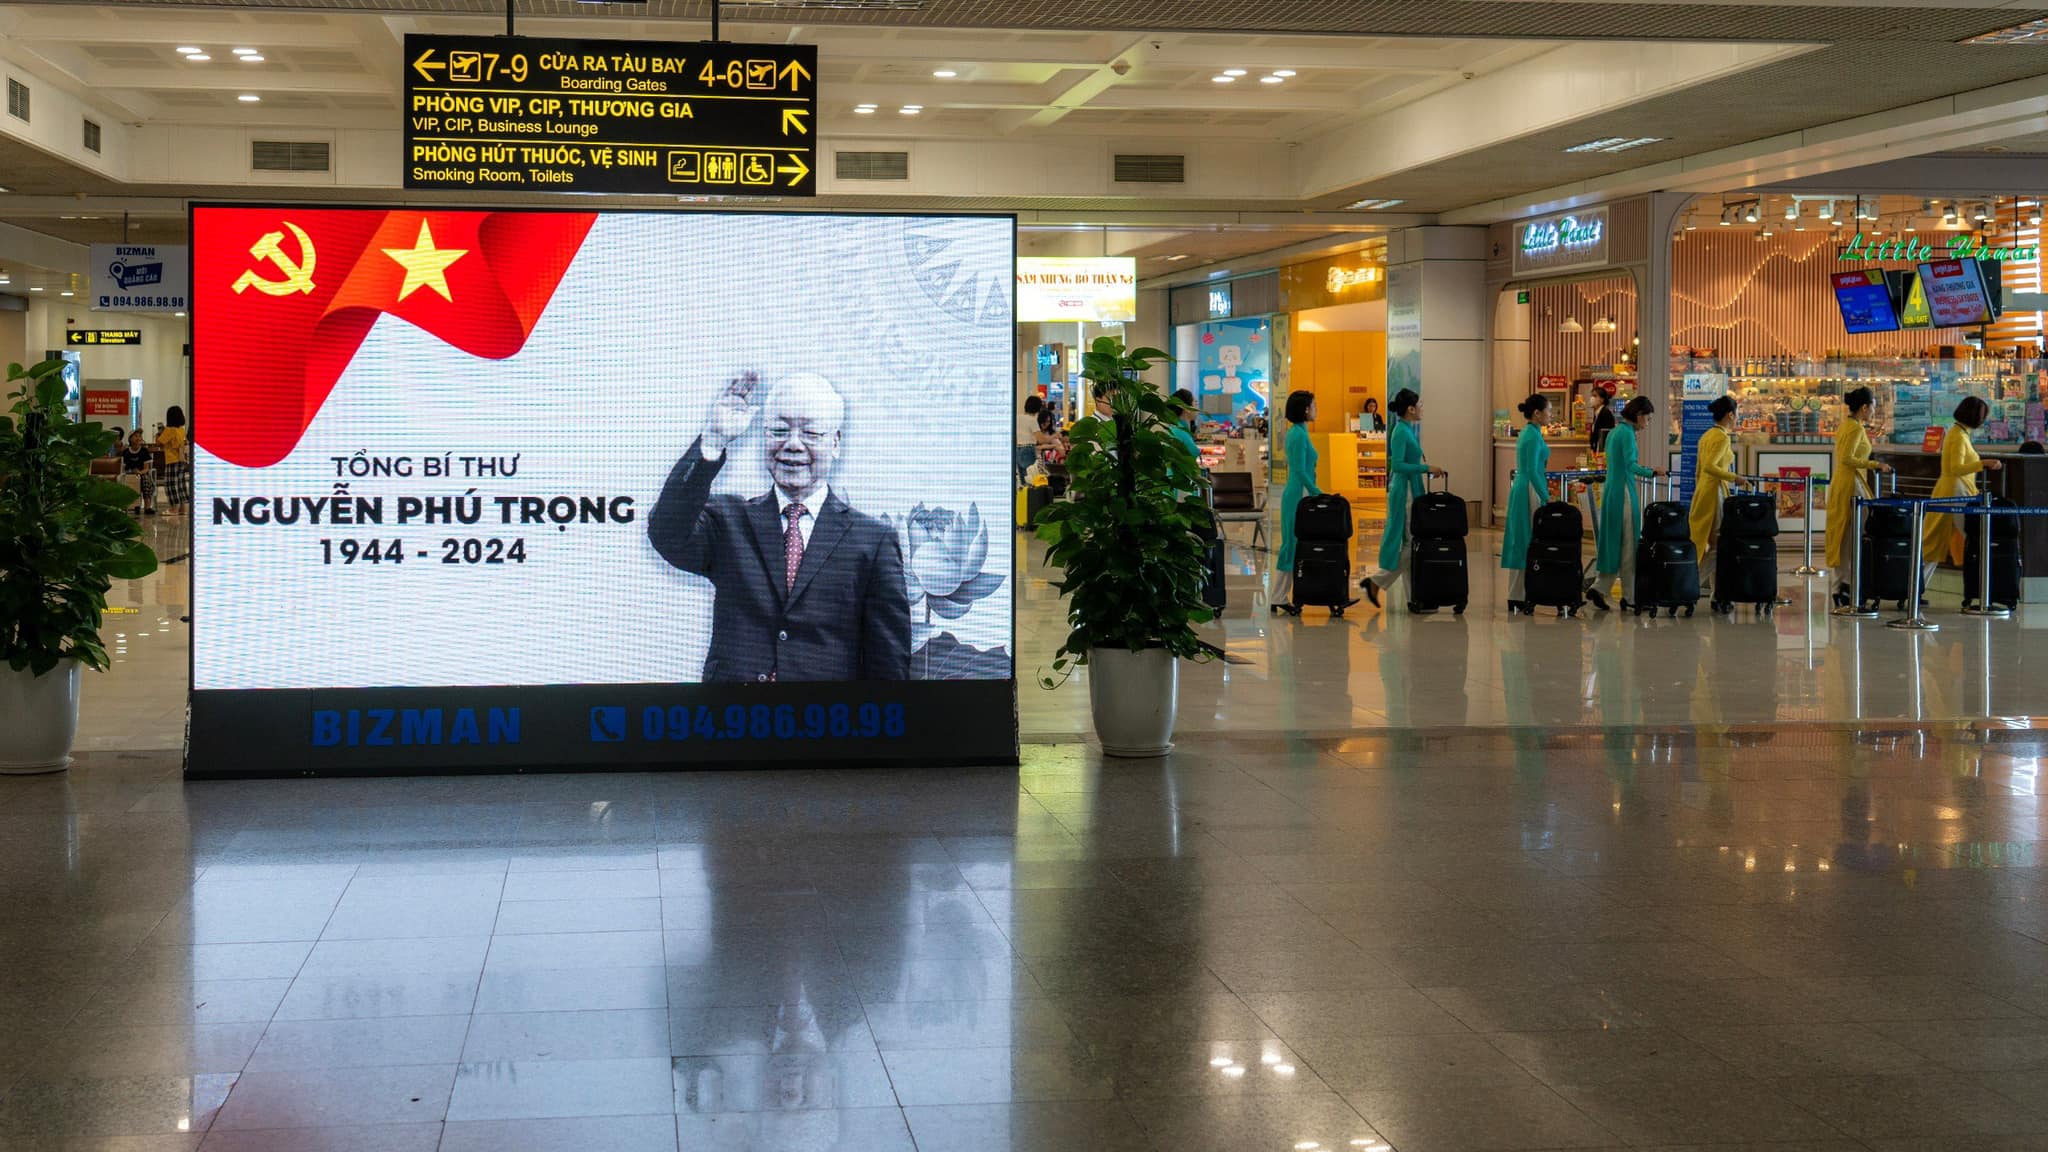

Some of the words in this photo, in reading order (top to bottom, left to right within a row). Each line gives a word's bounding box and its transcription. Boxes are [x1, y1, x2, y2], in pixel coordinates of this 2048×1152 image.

[483, 53, 528, 82] 7-9
[539, 51, 579, 71] CỬA
[583, 55, 608, 71] RA
[611, 53, 647, 73] TÀU
[652, 58, 686, 73] BAY
[698, 59, 744, 88] 4-6
[561, 76, 622, 92] Boarding
[626, 78, 667, 91] Gates
[412, 93, 484, 112] PHÒNG
[489, 98, 523, 115] VIP,
[528, 99, 563, 117] CIP,
[569, 100, 654, 117] THƯƠNG
[660, 102, 694, 118] GIA
[413, 117, 440, 132] VIP,
[445, 119, 473, 133] CIP,
[478, 119, 542, 133] Business
[546, 121, 598, 137] Lounge
[413, 143, 477, 162] PHÒNG
[481, 144, 516, 163] HÚT
[590, 147, 613, 169] VỆ
[617, 151, 658, 166] SINH
[413, 168, 475, 183] Smoking
[479, 169, 525, 183] Room,
[529, 170, 574, 183] Toilets
[1521, 222, 1557, 251] Little
[1839, 232, 1932, 262] Little
[1946, 234, 2040, 261] Hanoi
[116, 247, 156, 257] BIZMAN
[113, 296, 184, 307] 094.986.98.98
[1910, 277, 1923, 311] 4
[331, 449, 413, 477] TỔNG
[424, 451, 452, 477] BÍ
[459, 453, 520, 477] THƯ
[213, 483, 383, 525] NGUYỄN
[397, 488, 482, 524] PHÚ
[494, 496, 635, 532] TRỌNG
[320, 539, 404, 564] 1944
[442, 538, 526, 564] 2024
[312, 708, 521, 746] BIZMAN
[643, 704, 905, 741] 094.986.98.98
